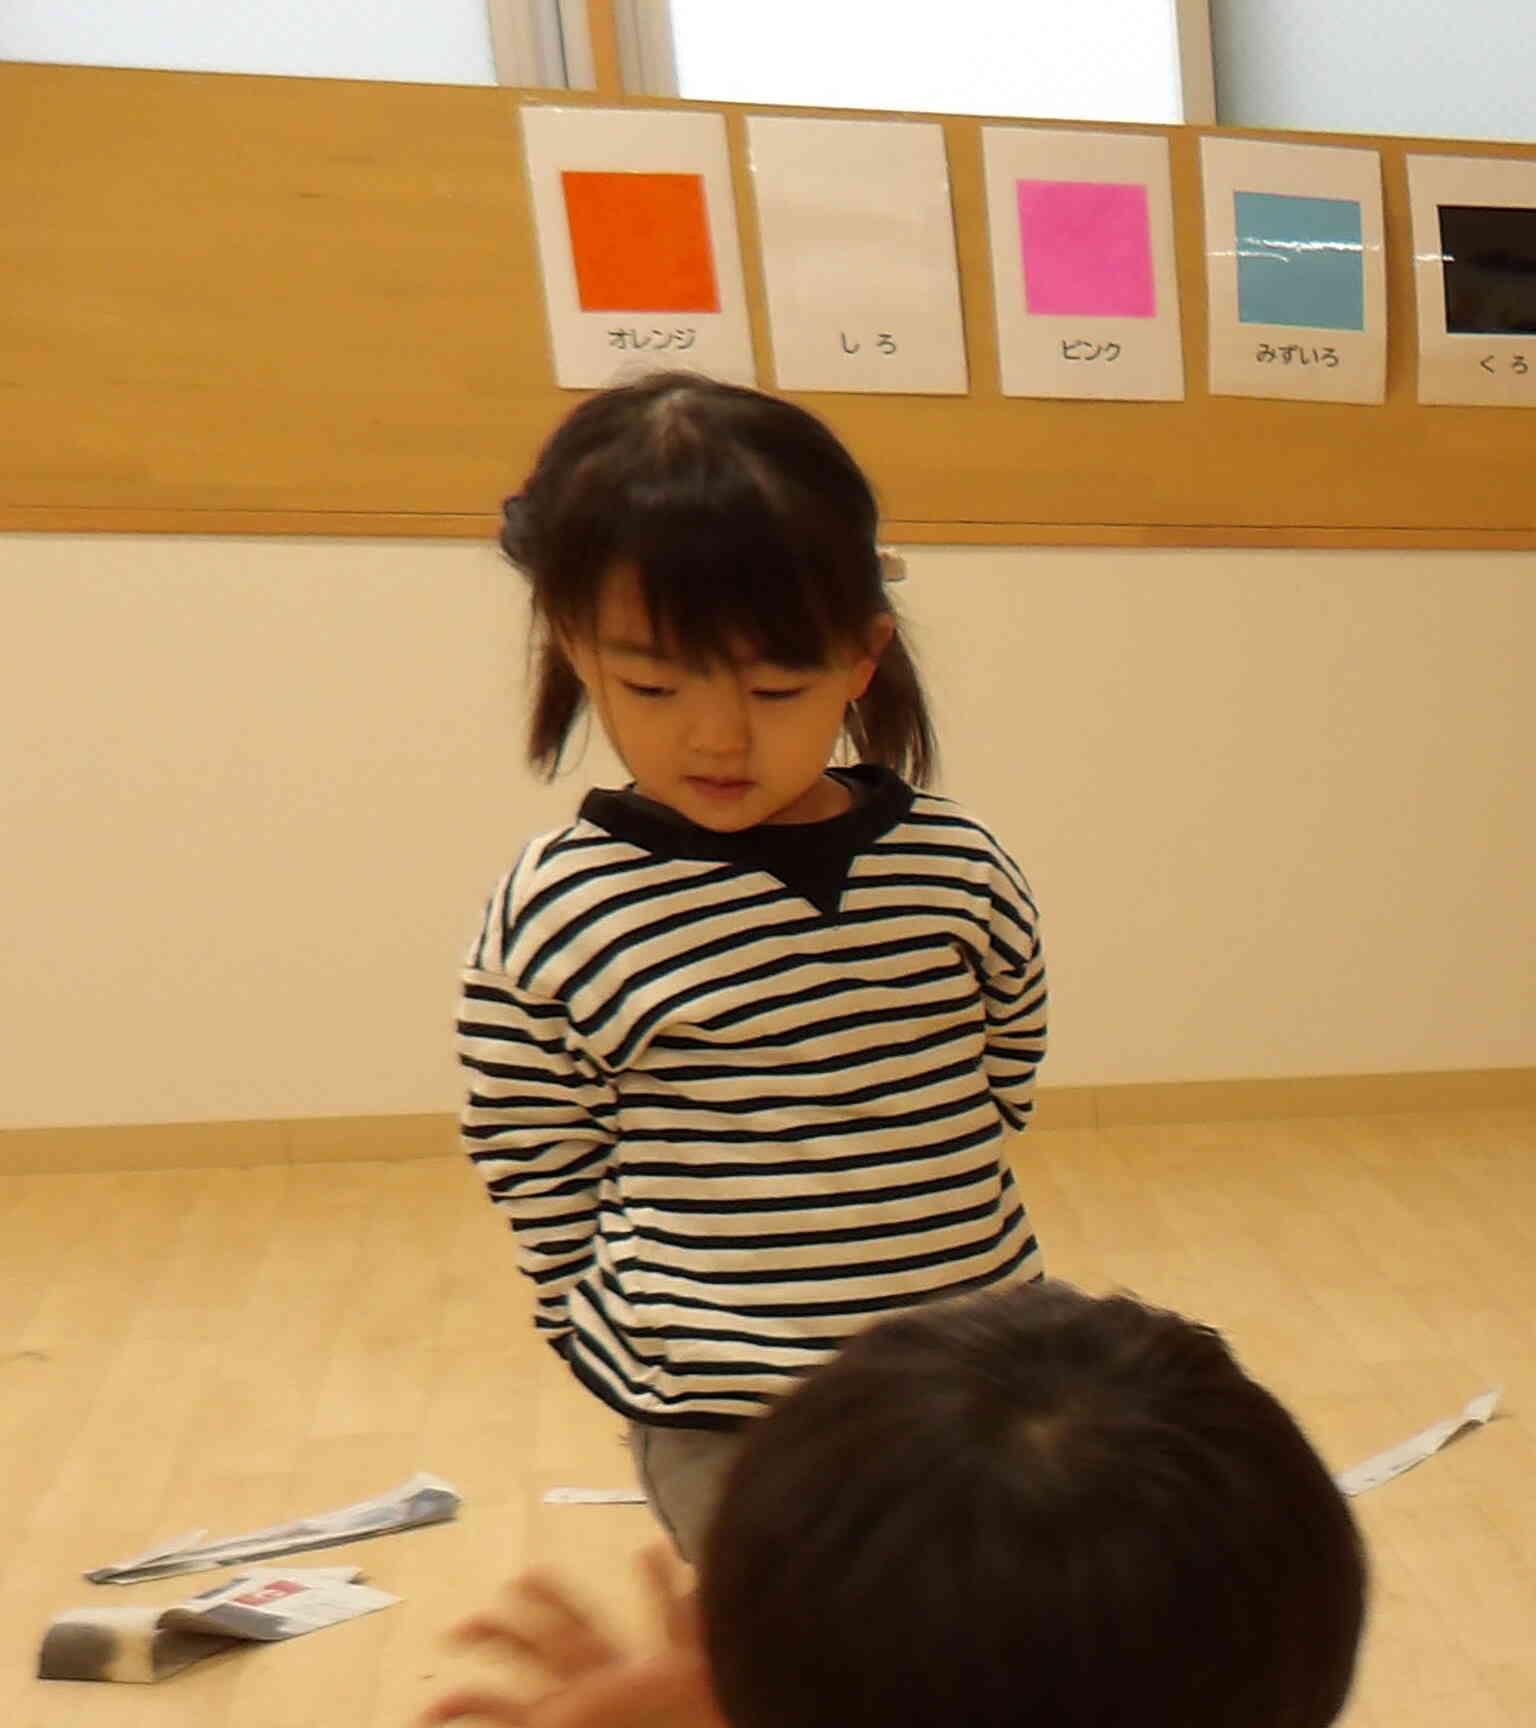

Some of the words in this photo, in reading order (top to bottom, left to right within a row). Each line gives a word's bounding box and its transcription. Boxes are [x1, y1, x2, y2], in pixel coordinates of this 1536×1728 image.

[607, 327, 696, 351] オレンジ
[840, 331, 898, 356] しろ
[1060, 338, 1122, 362] ピンク
[1255, 342, 1340, 368] みずいろ
[1479, 354, 1530, 375] くろ
